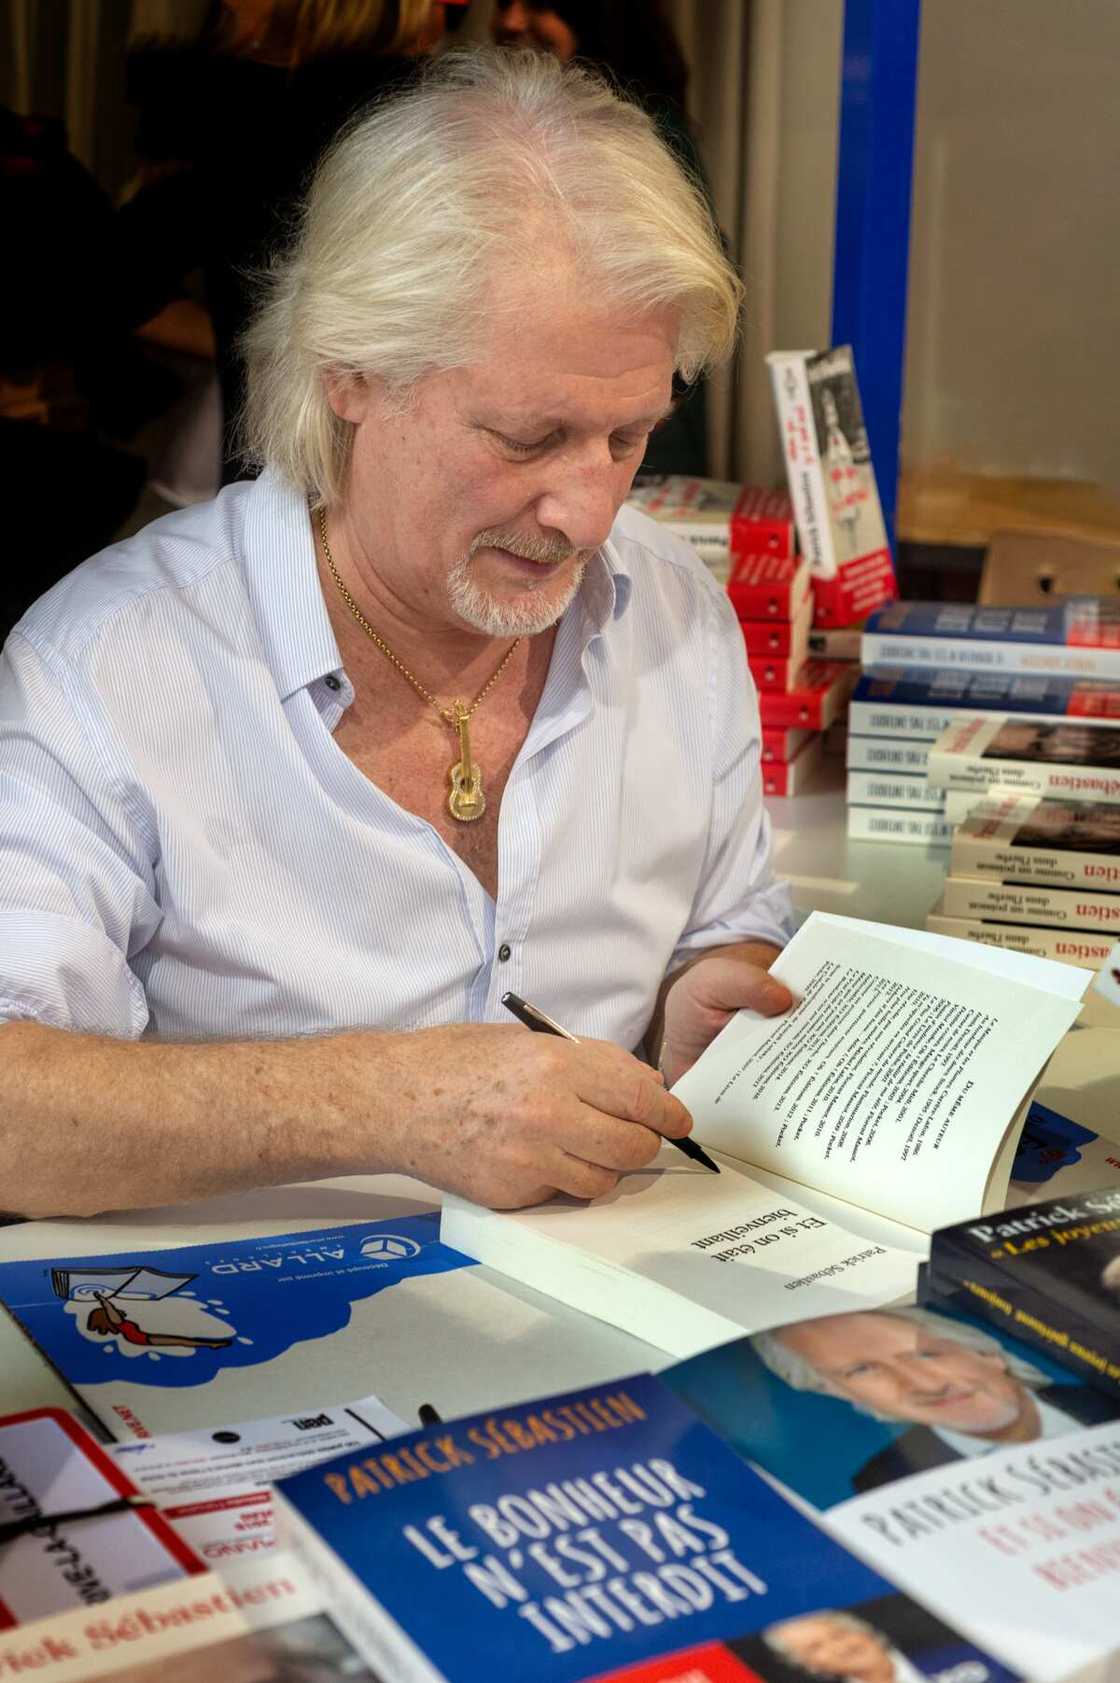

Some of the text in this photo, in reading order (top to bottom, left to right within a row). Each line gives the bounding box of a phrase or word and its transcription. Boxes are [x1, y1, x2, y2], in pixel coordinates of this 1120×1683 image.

[691, 1207, 798, 1250] bienveillant
[710, 1216, 828, 1263] Et si on était
[967, 1205, 1088, 1244] Patrick
[211, 1248, 345, 1275] ALLARD
[783, 1246, 887, 1292] Patrick Sébastien
[324, 1434, 476, 1505] PATRICK
[468, 1391, 648, 1460] SÉBASTIEN
[403, 1458, 707, 1569] LE BONHEUR
[861, 1476, 1025, 1547] PATRICK
[463, 1503, 731, 1610] N'EST PAS
[83, 1578, 298, 1651] Sébastien
[517, 1548, 769, 1654] INTERDIT
